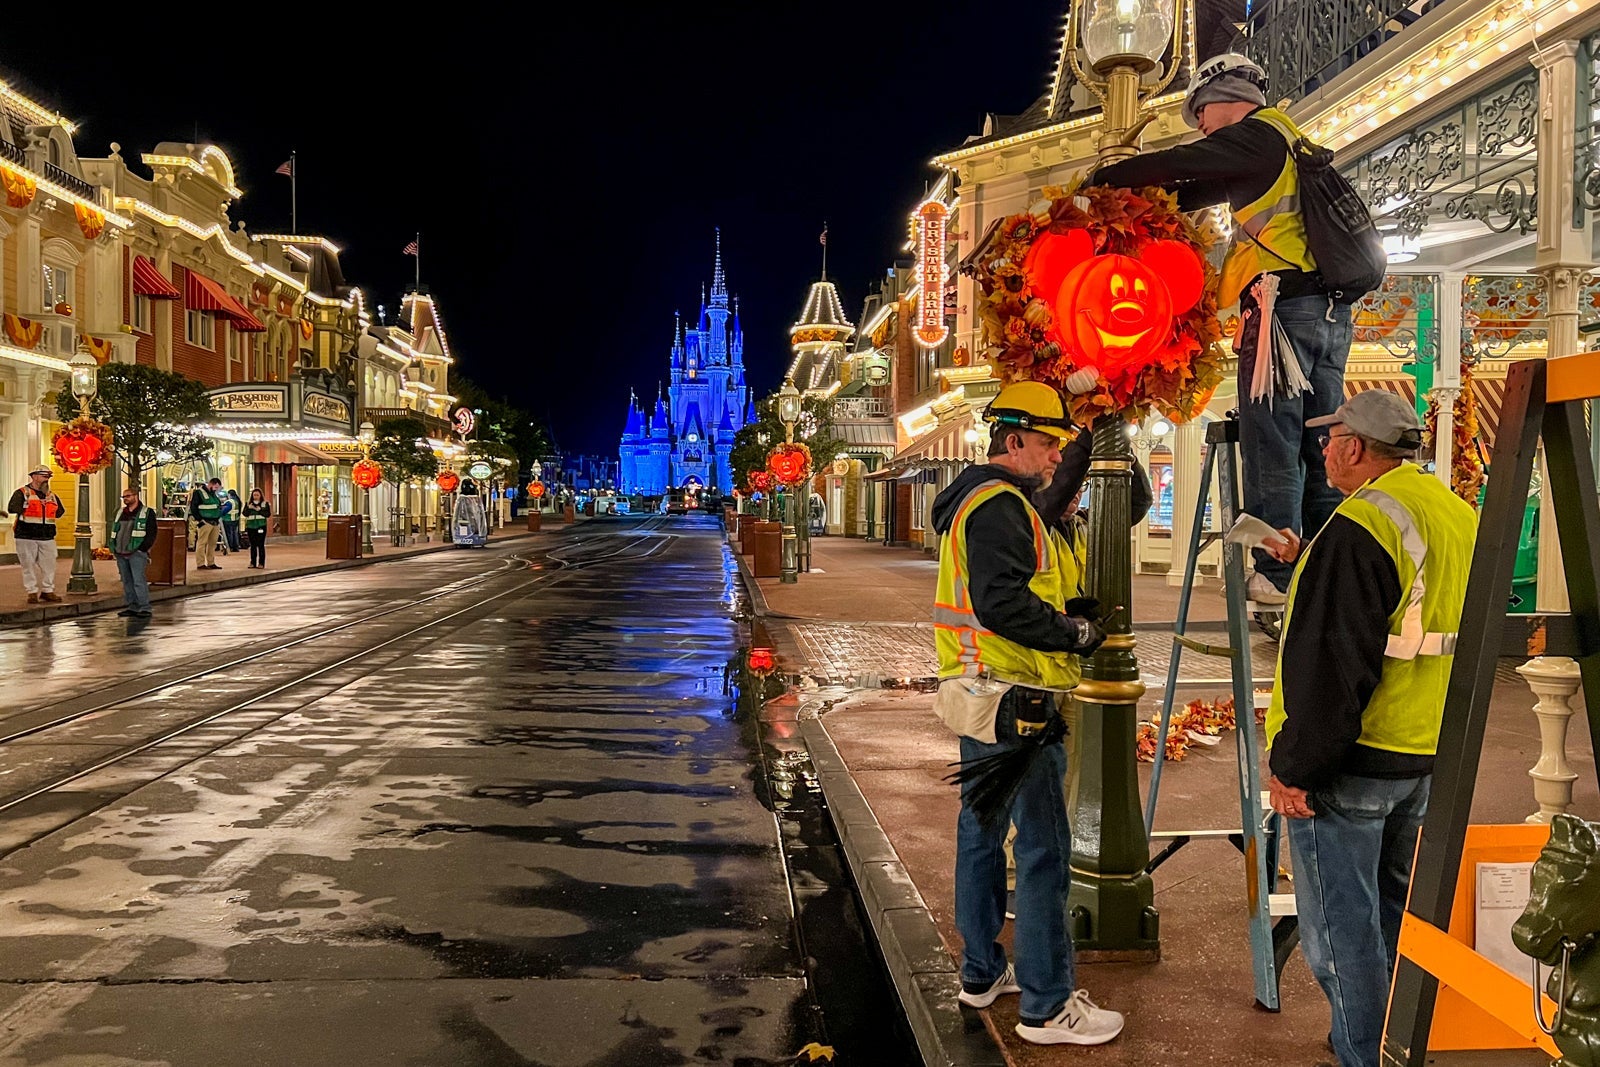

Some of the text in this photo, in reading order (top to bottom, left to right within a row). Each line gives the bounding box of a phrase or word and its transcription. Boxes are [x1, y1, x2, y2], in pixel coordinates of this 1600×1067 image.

[925, 220, 940, 326] CRYSTAL ARTS
[227, 394, 279, 409] FASHION
[318, 443, 345, 451] HOUSE
[346, 443, 357, 451] OF
